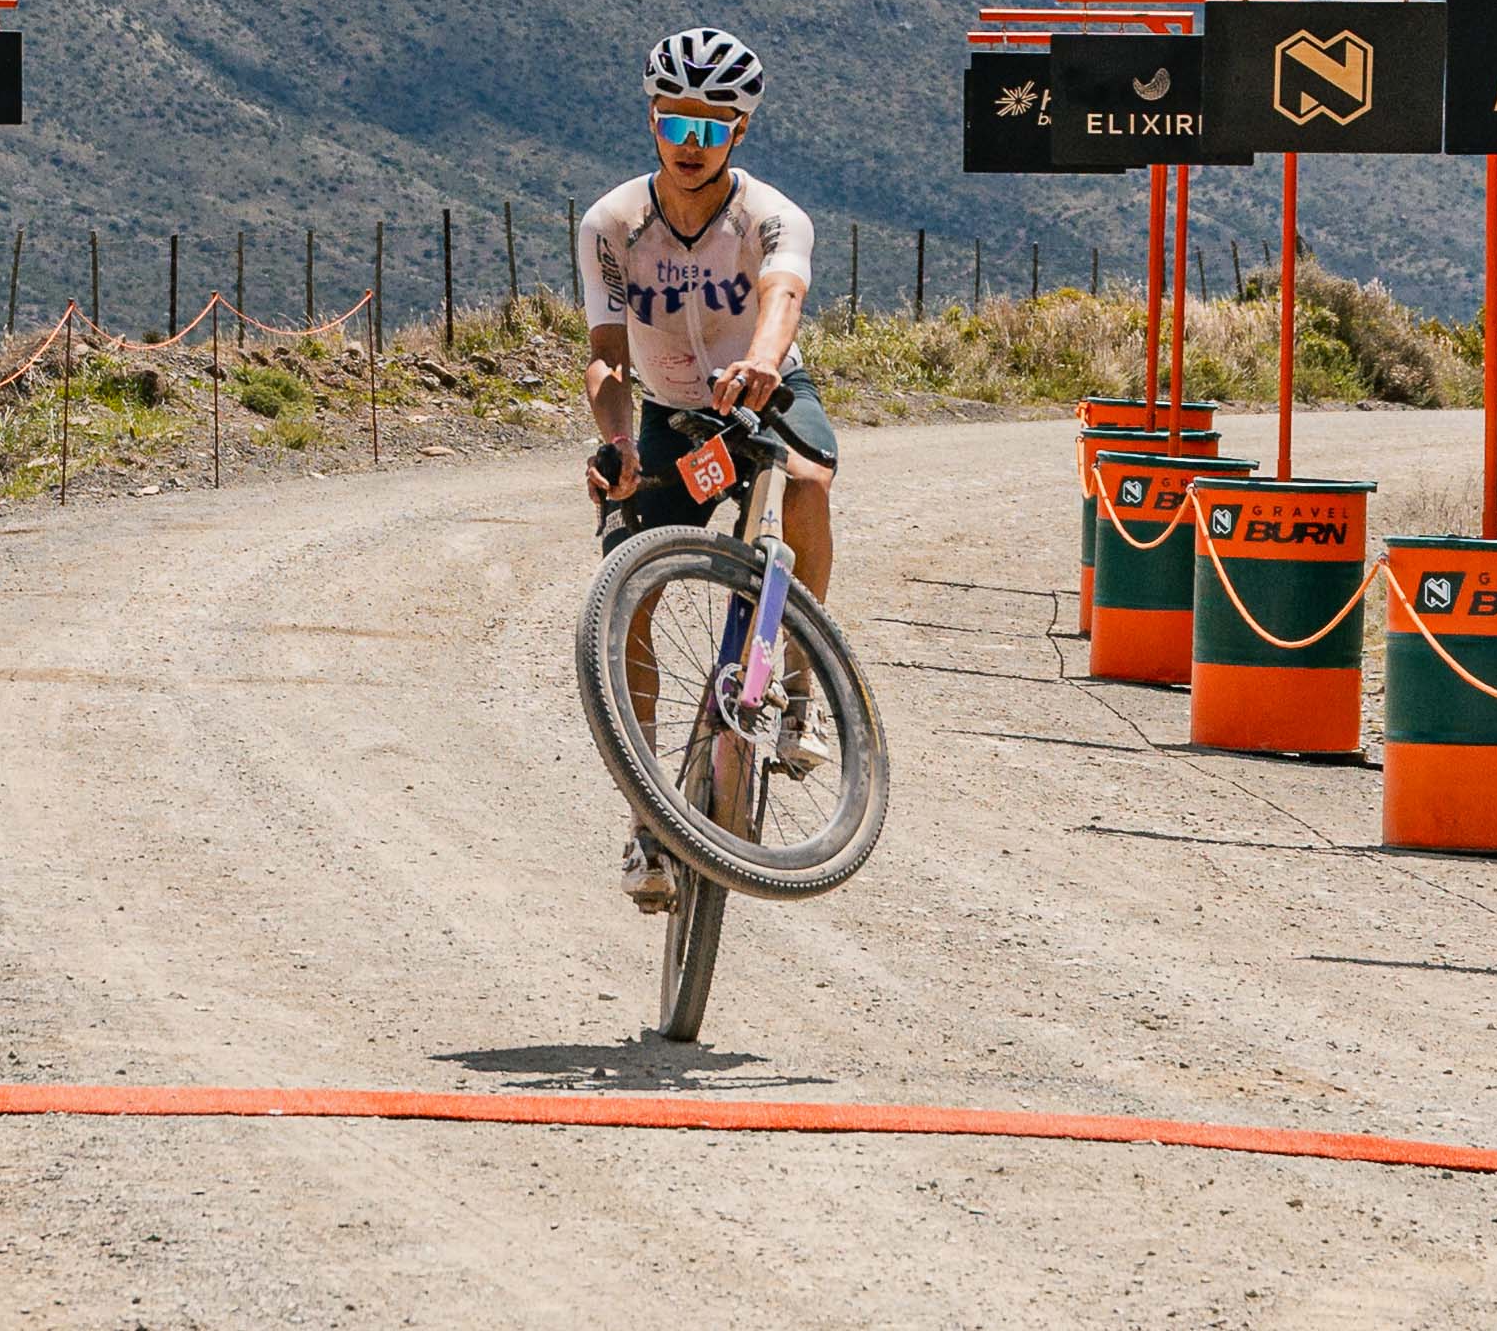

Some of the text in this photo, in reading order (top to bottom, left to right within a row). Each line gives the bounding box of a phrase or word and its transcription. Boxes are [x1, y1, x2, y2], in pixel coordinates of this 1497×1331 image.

[1087, 114, 1202, 135] ELIXIR
[694, 461, 725, 492] 59
[1252, 505, 1349, 519] GRAVEL
[1244, 520, 1348, 545] BURN
